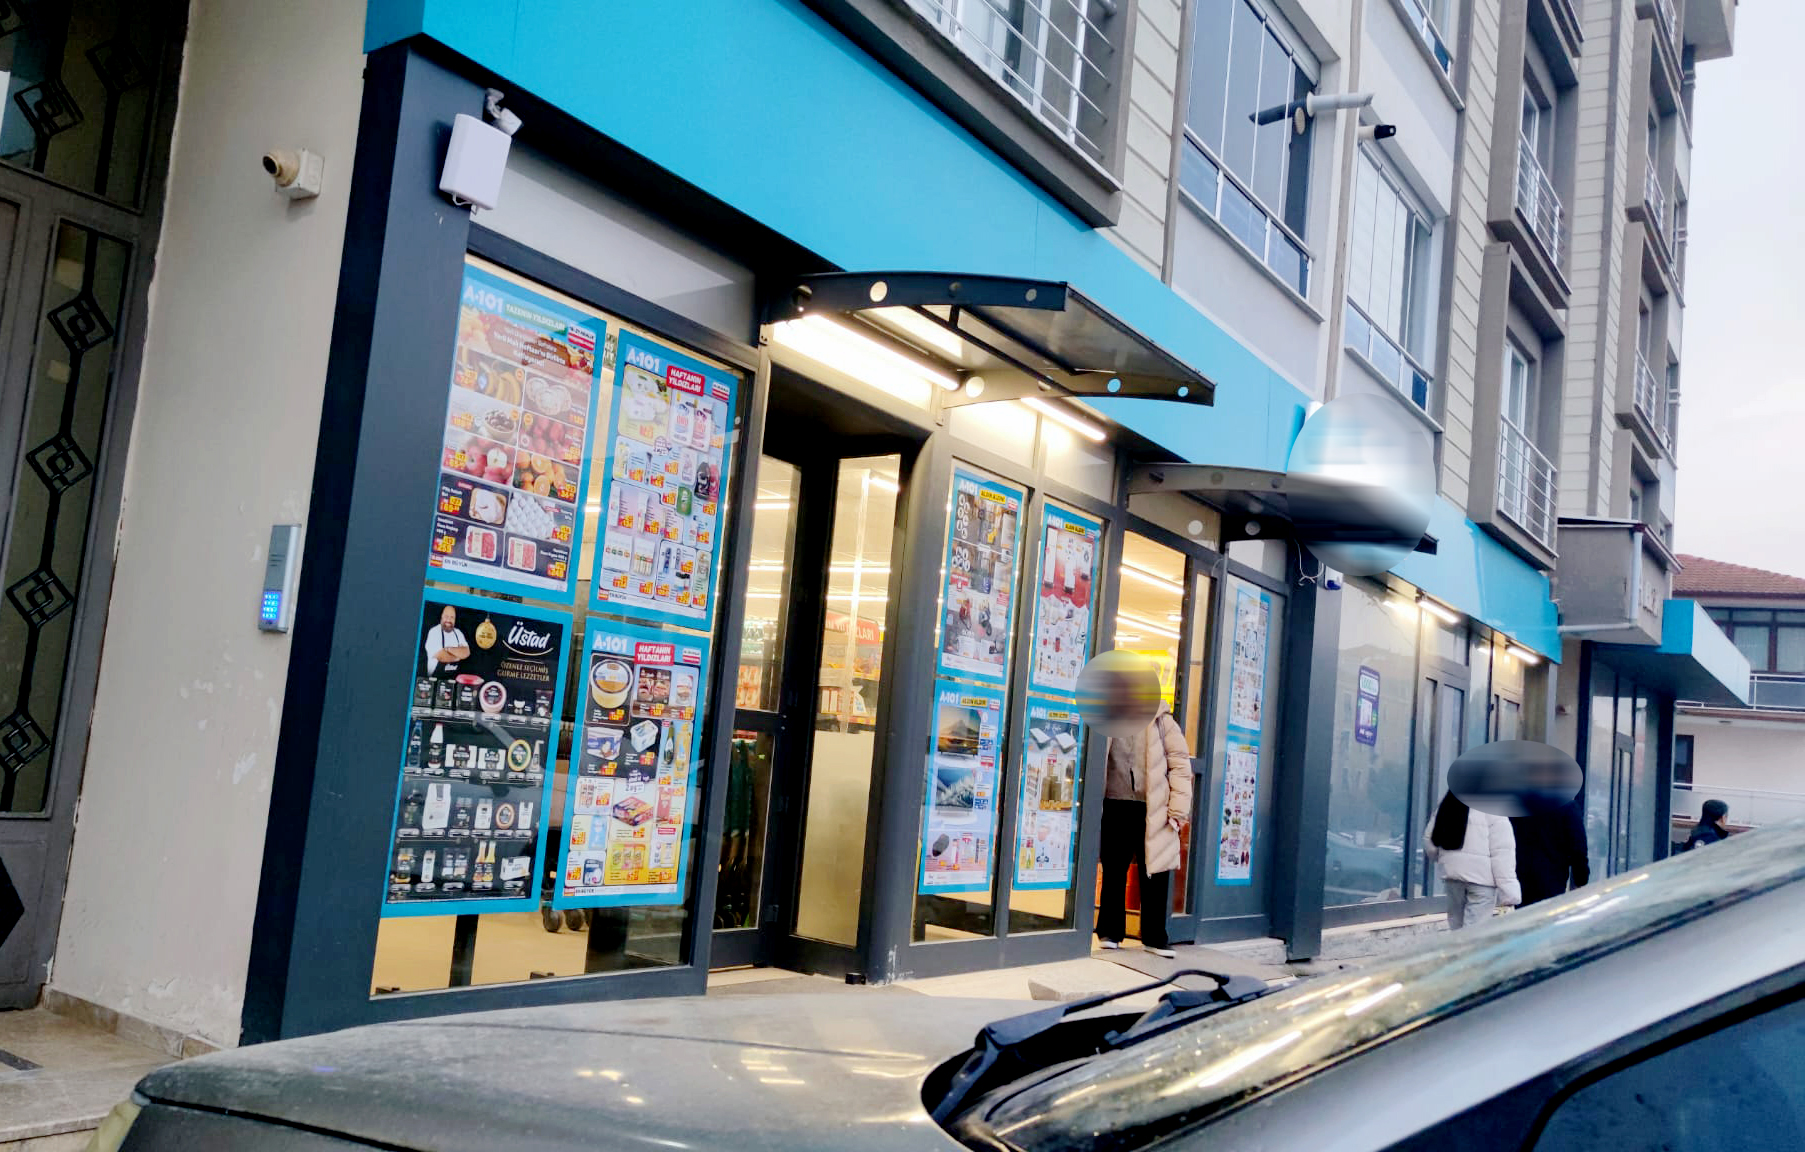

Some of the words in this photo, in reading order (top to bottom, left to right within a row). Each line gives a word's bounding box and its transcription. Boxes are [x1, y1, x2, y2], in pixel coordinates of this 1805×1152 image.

[670, 367, 702, 384] HAFTANIN
[668, 377, 702, 393] YILDIZLARI
[507, 620, 551, 649] Üstad
[638, 644, 671, 655] HAFTANIN
[637, 653, 672, 663] YILDIZLARI
